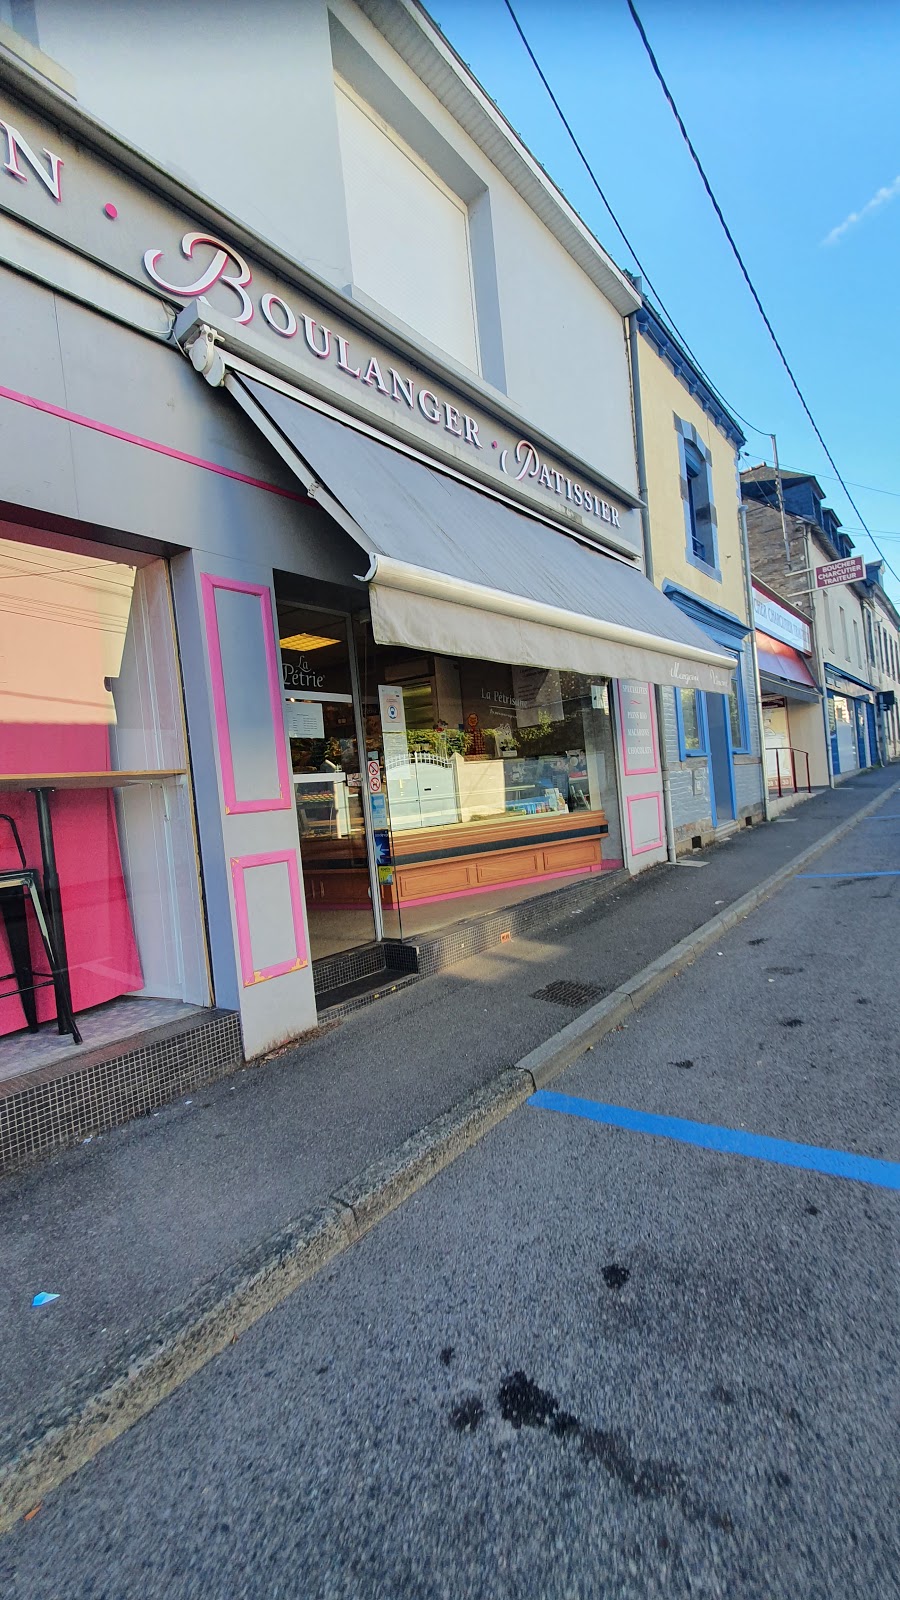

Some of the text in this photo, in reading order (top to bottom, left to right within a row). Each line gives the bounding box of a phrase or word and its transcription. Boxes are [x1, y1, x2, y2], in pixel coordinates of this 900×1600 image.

[143, 232, 484, 450] BOULANGER
[500, 440, 622, 529] PATISSIER
[818, 565, 862, 581] CHARCUTIER
[822, 559, 856, 573] BOUCHER
[823, 573, 857, 585] TRAITEUR
[297, 655, 311, 672] La
[282, 662, 324, 688] Pétrie
[481, 688, 491, 700] La
[627, 728, 650, 737] MACARONS
[627, 746, 653, 755] CHOCOLATS
